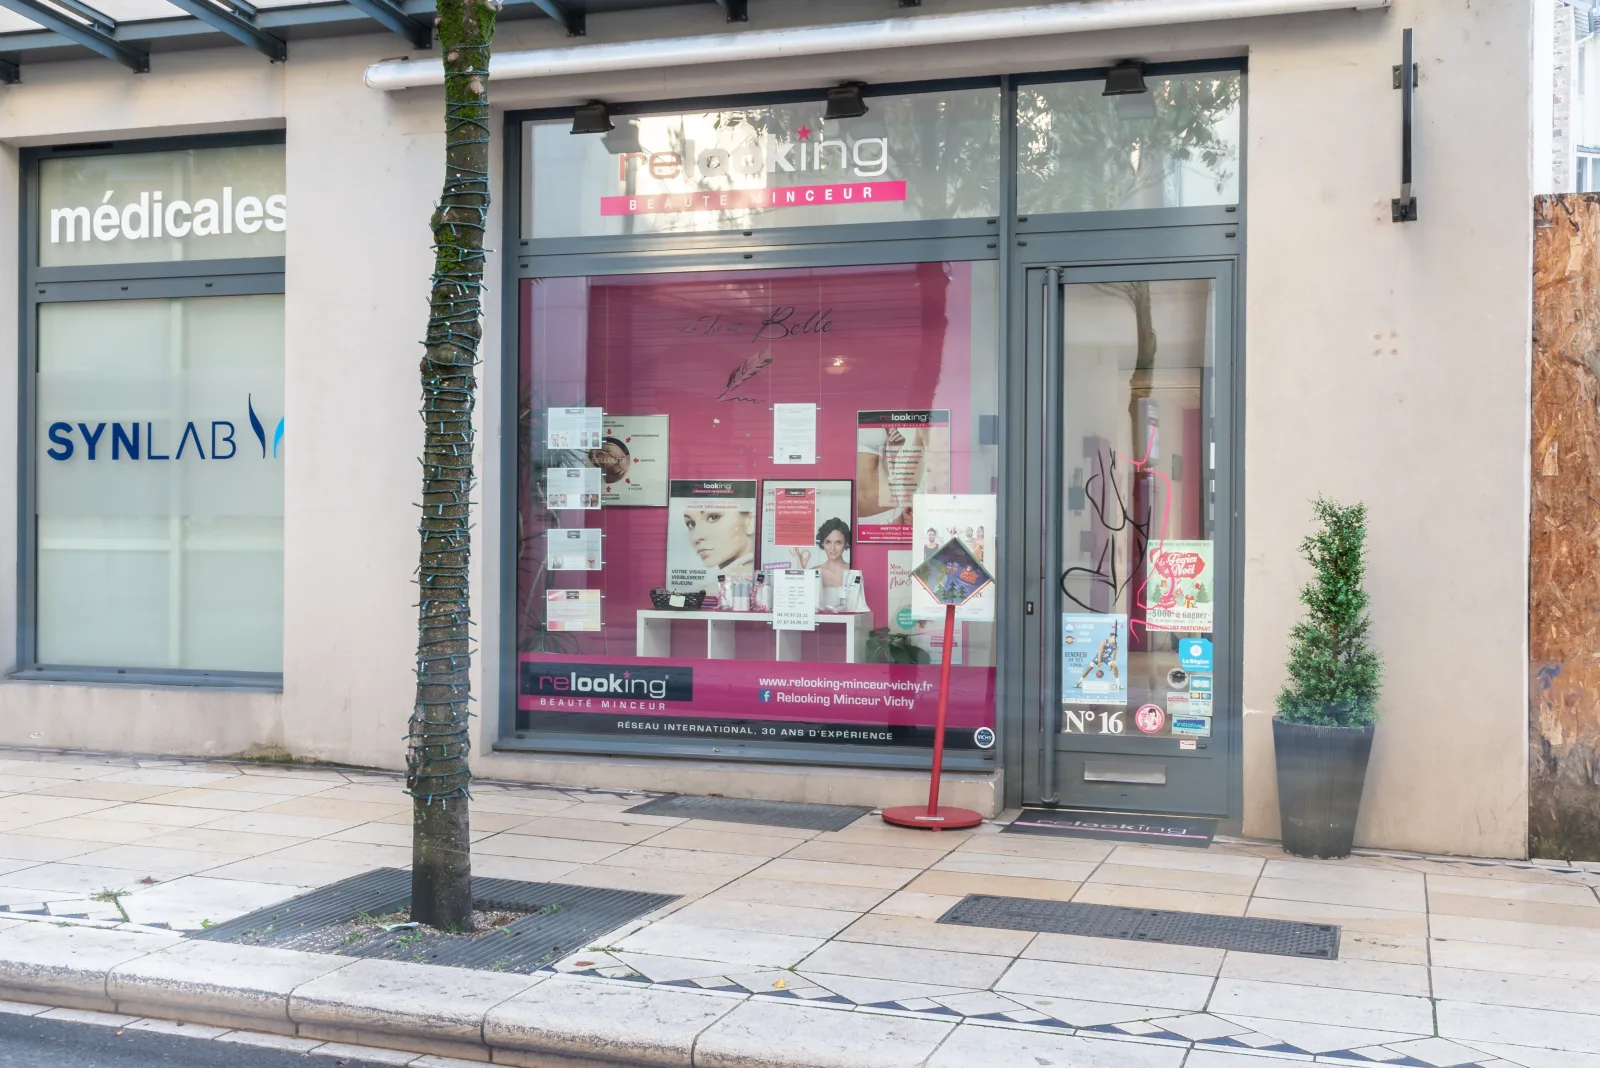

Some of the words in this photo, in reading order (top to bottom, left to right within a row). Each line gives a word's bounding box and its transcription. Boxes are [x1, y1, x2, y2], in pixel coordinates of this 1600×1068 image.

[619, 126, 889, 182] relooking
[750, 187, 873, 206] MINCEUR
[50, 186, 286, 243] médicales
[752, 306, 833, 343] Belle
[47, 421, 237, 461] SYNLAB
[1171, 563, 1195, 576] Noël
[1190, 658, 1210, 666] Région
[539, 671, 667, 699] relooking
[759, 677, 933, 692] www.relooking-minceur-vichy.fr
[540, 698, 592, 708] BEAUTÉ
[601, 700, 666, 711] MINCEUR
[776, 691, 830, 706] Relooking
[834, 694, 881, 707] Minceur
[884, 695, 915, 710] Vichy
[617, 721, 660, 730] RÉSEAU
[664, 724, 757, 735] INTERNATIONAL,
[761, 727, 776, 736] 30
[780, 729, 805, 737] ANS
[809, 729, 893, 741] D'EXPÉRIENCE
[1099, 711, 1124, 734] 16
[1037, 819, 1187, 835] relooking
